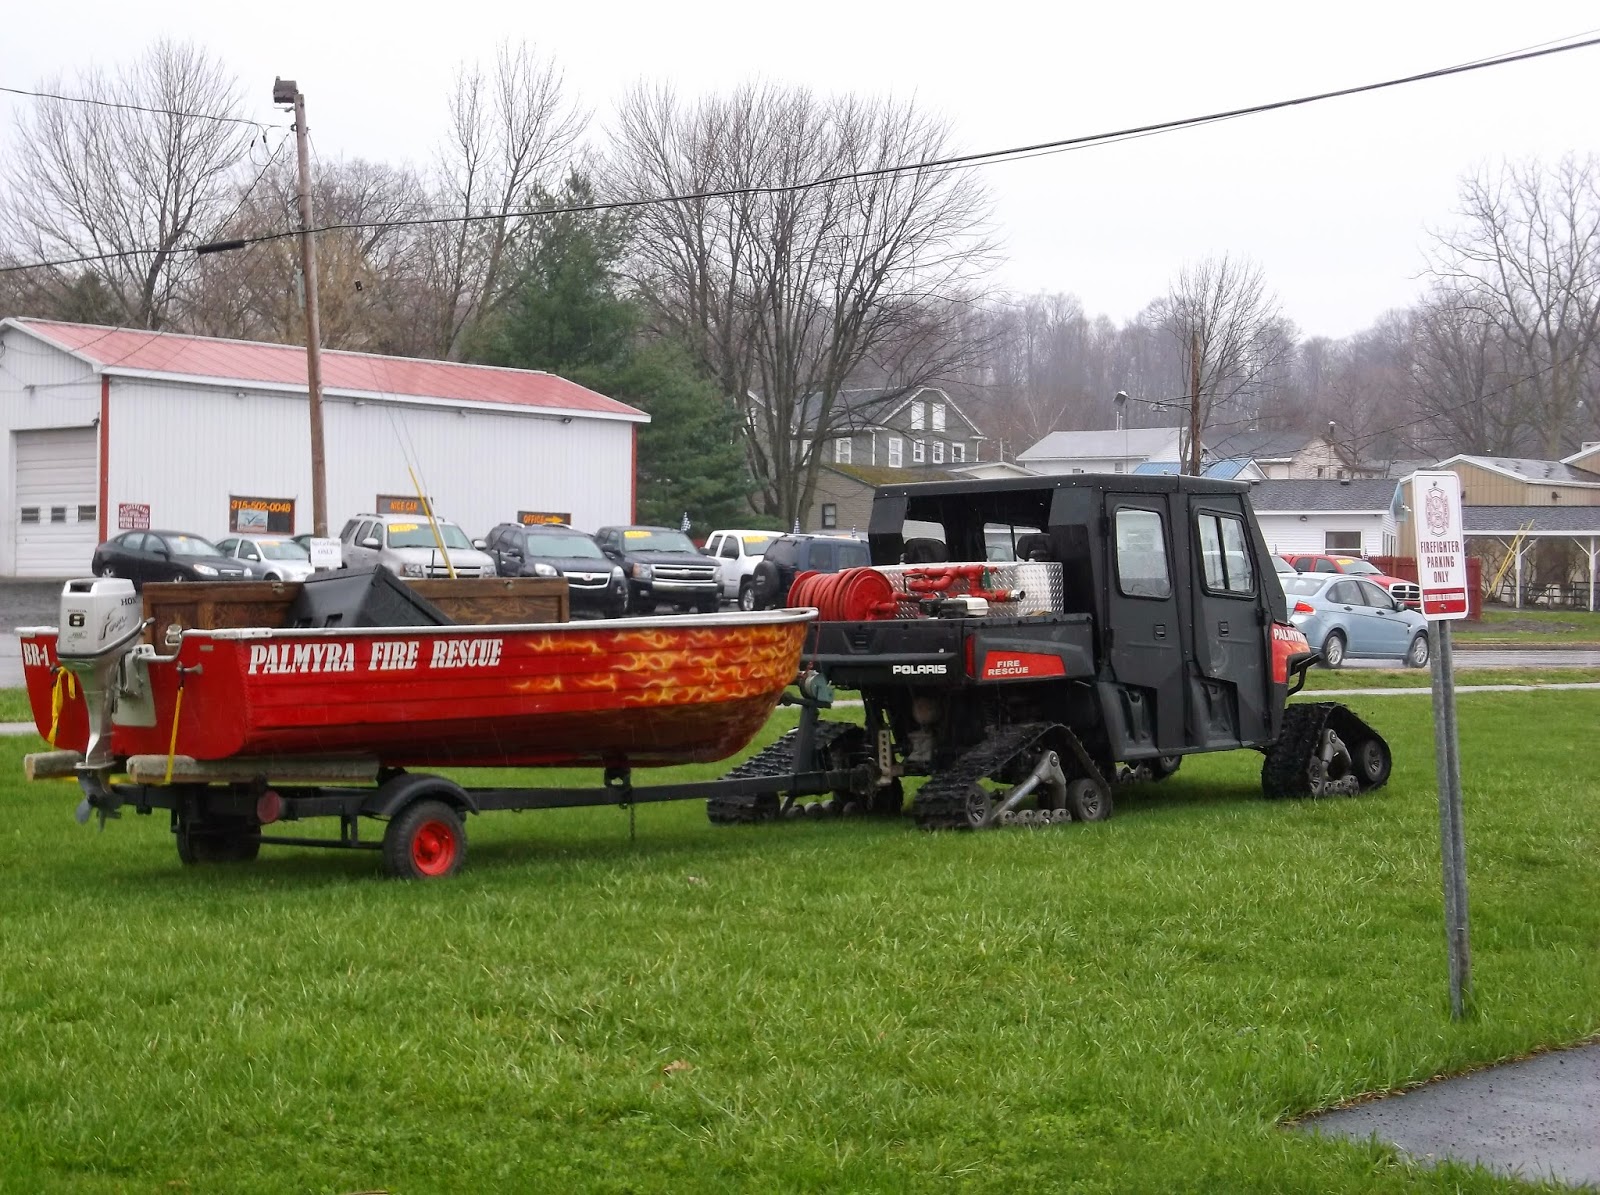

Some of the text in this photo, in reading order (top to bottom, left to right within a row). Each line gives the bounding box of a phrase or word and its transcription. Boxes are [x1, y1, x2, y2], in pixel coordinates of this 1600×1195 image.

[231, 500, 291, 512] 315-502-0048
[523, 515, 545, 524] OFFICE
[1420, 541, 1460, 553] FIREFIGHTER
[1427, 556, 1455, 568] PARKING
[1433, 571, 1449, 583] ONLY
[69, 614, 85, 627] 8
[22, 643, 50, 666] BR-1
[248, 639, 503, 675] PALMYRA FIRE RESCUE
[893, 664, 947, 674] POLARIS
[988, 667, 1028, 676] RESCUE
